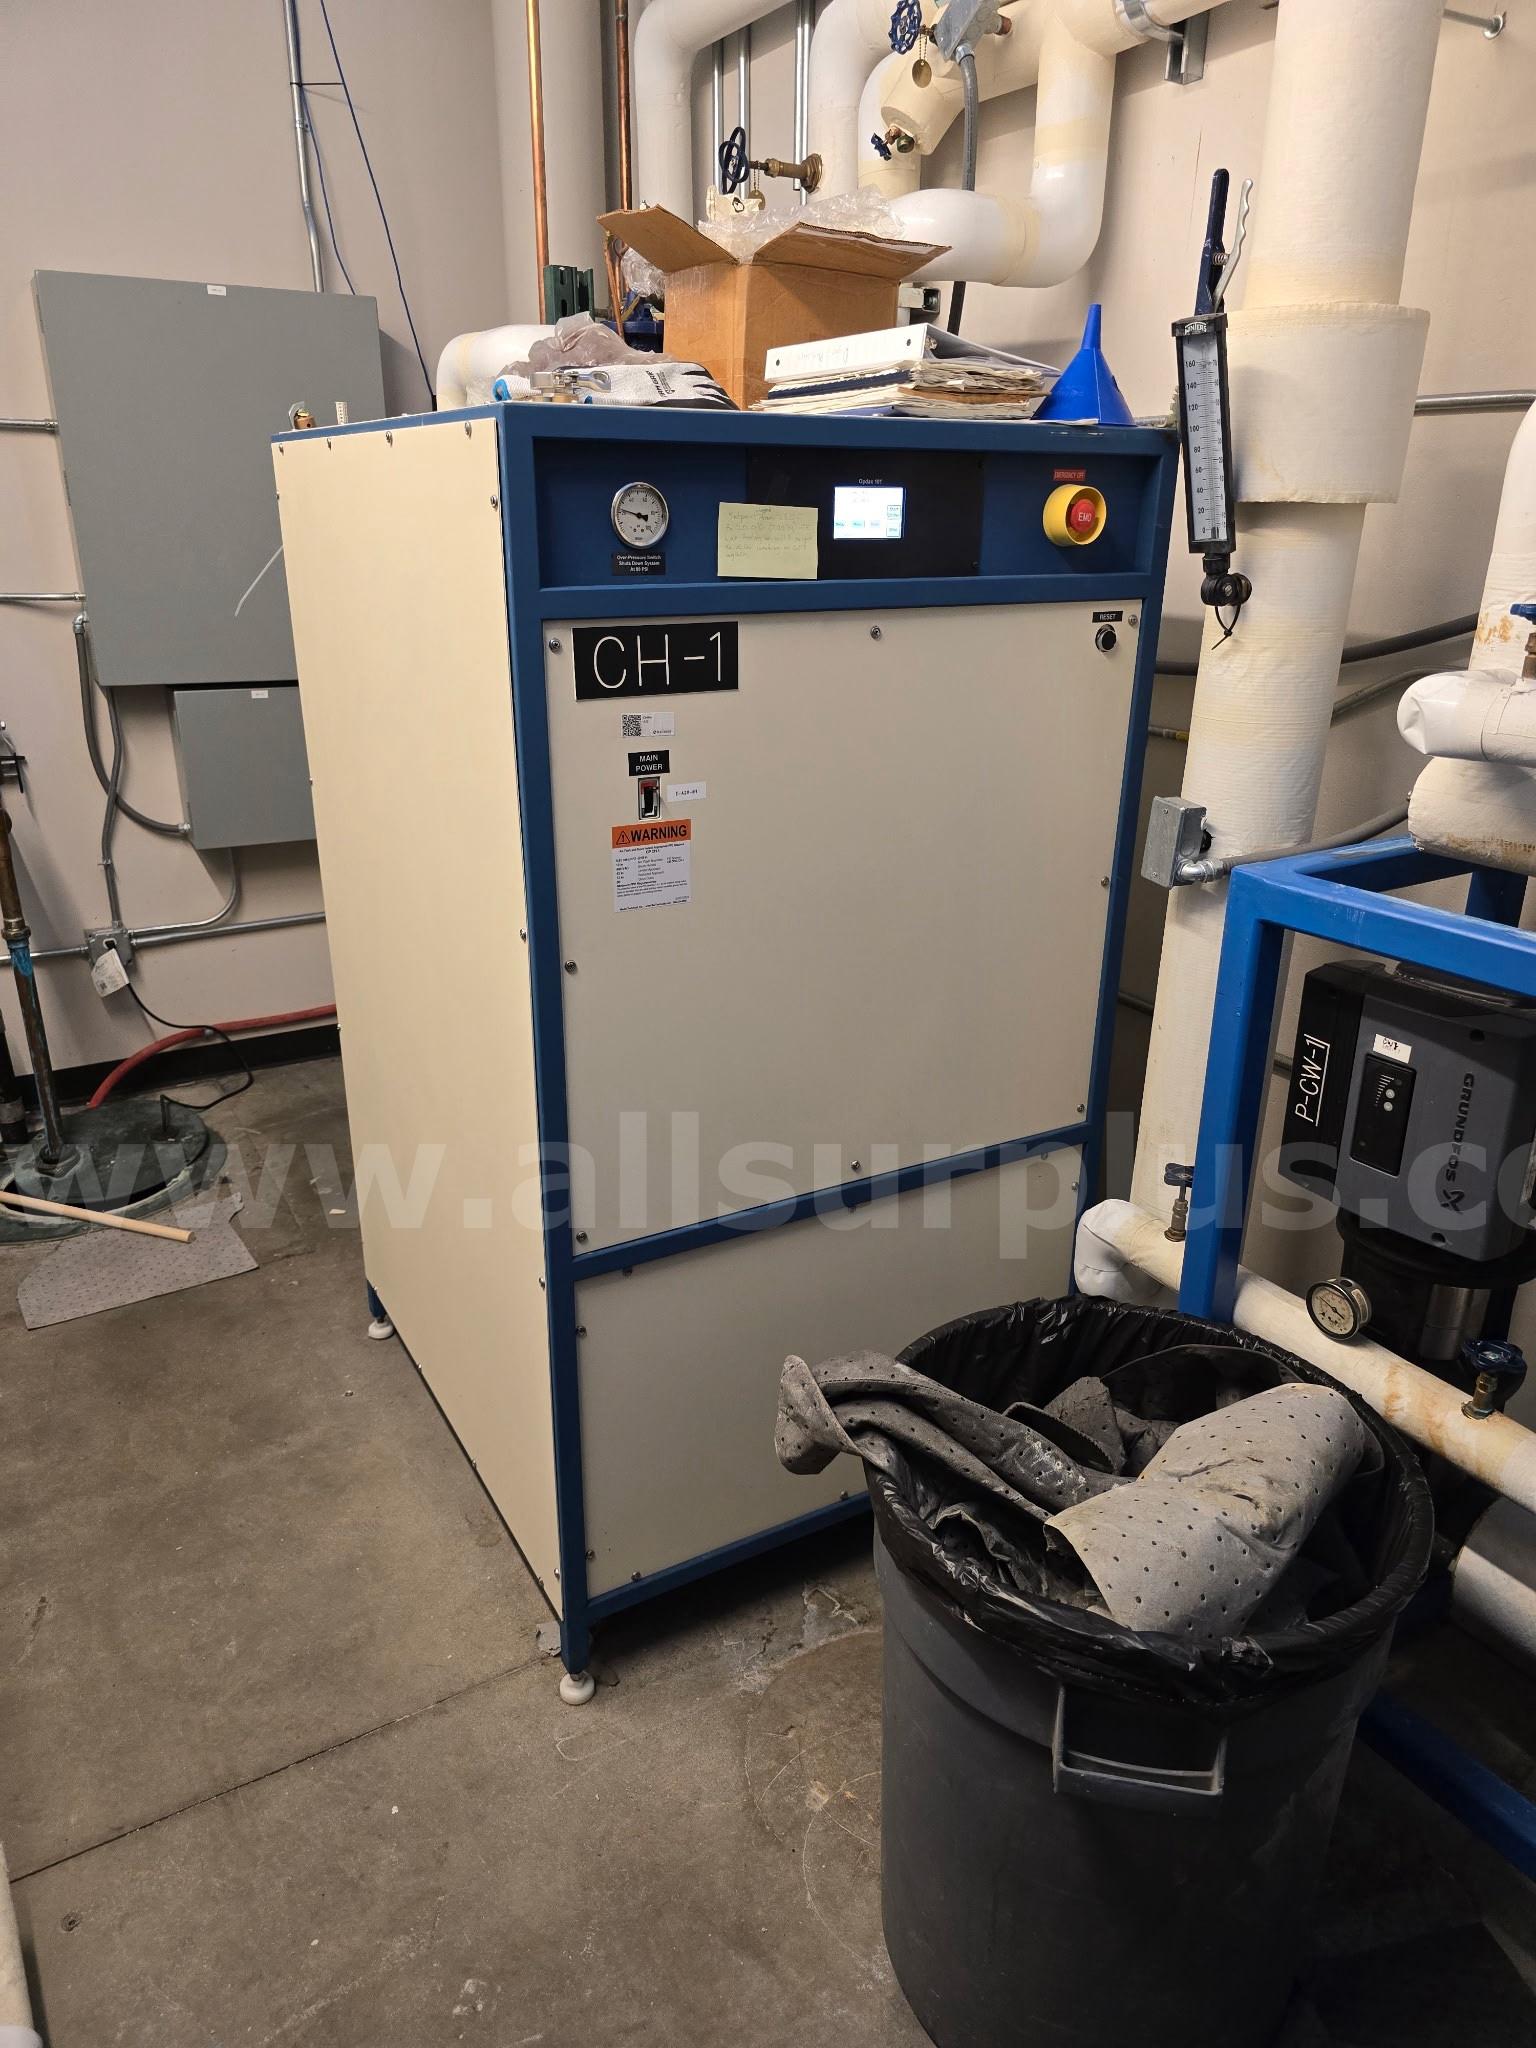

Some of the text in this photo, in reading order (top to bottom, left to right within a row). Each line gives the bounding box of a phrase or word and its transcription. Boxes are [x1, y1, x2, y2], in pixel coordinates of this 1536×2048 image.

[1185, 360, 1195, 368] 160
[1186, 382, 1197, 390] 140
[1188, 403, 1198, 411] 120
[593, 631, 721, 689] CH-1
[639, 754, 659, 763] MAIN
[635, 763, 663, 773] POWER
[631, 825, 687, 842] WARNING
[1295, 1038, 1326, 1123] P-CW-1
[1445, 1072, 1475, 1182] GRUNDFOS
